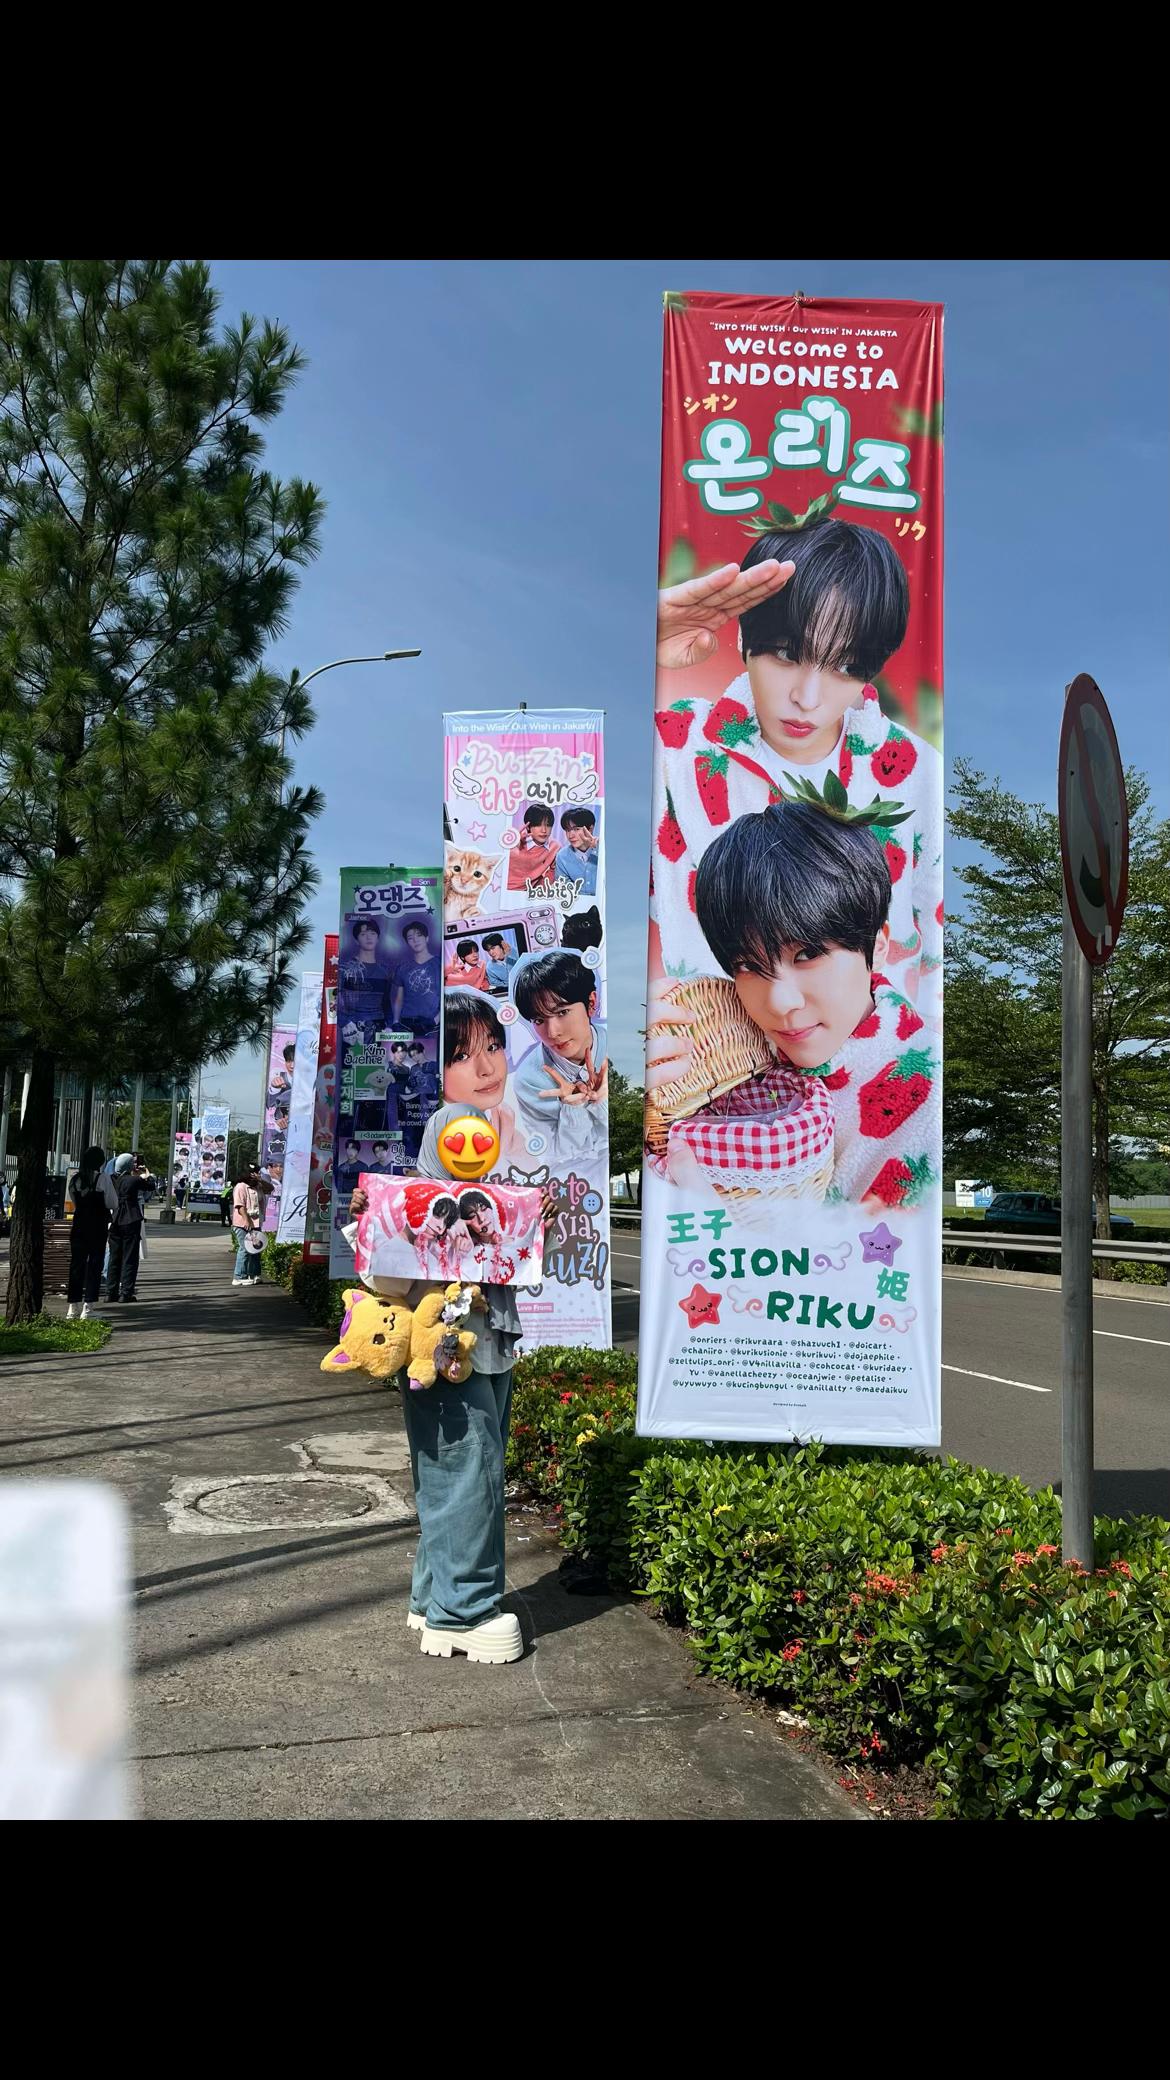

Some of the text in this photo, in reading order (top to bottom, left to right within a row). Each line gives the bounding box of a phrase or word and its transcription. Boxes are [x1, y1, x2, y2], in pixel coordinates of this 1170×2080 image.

[740, 324, 757, 332] THE
[793, 326, 808, 334] Our
[855, 329, 897, 337] JAKARTA
[724, 337, 883, 360] Welcome to
[708, 361, 899, 390] INDONESIA
[683, 393, 737, 415] シオン
[685, 397, 919, 514] 온리즈
[895, 517, 927, 541] リク
[452, 724, 469, 733] Into
[471, 723, 486, 732] the
[529, 722, 551, 731] Wish
[552, 722, 561, 730] in
[562, 721, 595, 730] Jakarta
[479, 777, 569, 812] the air
[358, 885, 426, 914] 오댕즈
[363, 1043, 386, 1056] Kim
[340, 1069, 354, 1116] 김재희
[666, 1209, 732, 1244] 王子
[708, 1247, 810, 1280] SION
[766, 1290, 876, 1330] RIKU
[681, 1346, 723, 1355] @chaniiro
[730, 1348, 788, 1357] @kurikusionie
[844, 1352, 895, 1361] @dojaephile
[690, 1335, 727, 1344] @onriers
[734, 1337, 783, 1346] @rikuraara
[849, 1341, 887, 1350] @doicart
[786, 1372, 836, 1382] @oceanjwie
[844, 1374, 886, 1383] @petalise
[809, 1362, 855, 1370] @cohcocat
[862, 1364, 907, 1373] @kuridaey
[673, 1379, 717, 1388] @uyuwuyo
[726, 1381, 788, 1391] @kucingbungul
[855, 1386, 908, 1394] @maedaikuu
